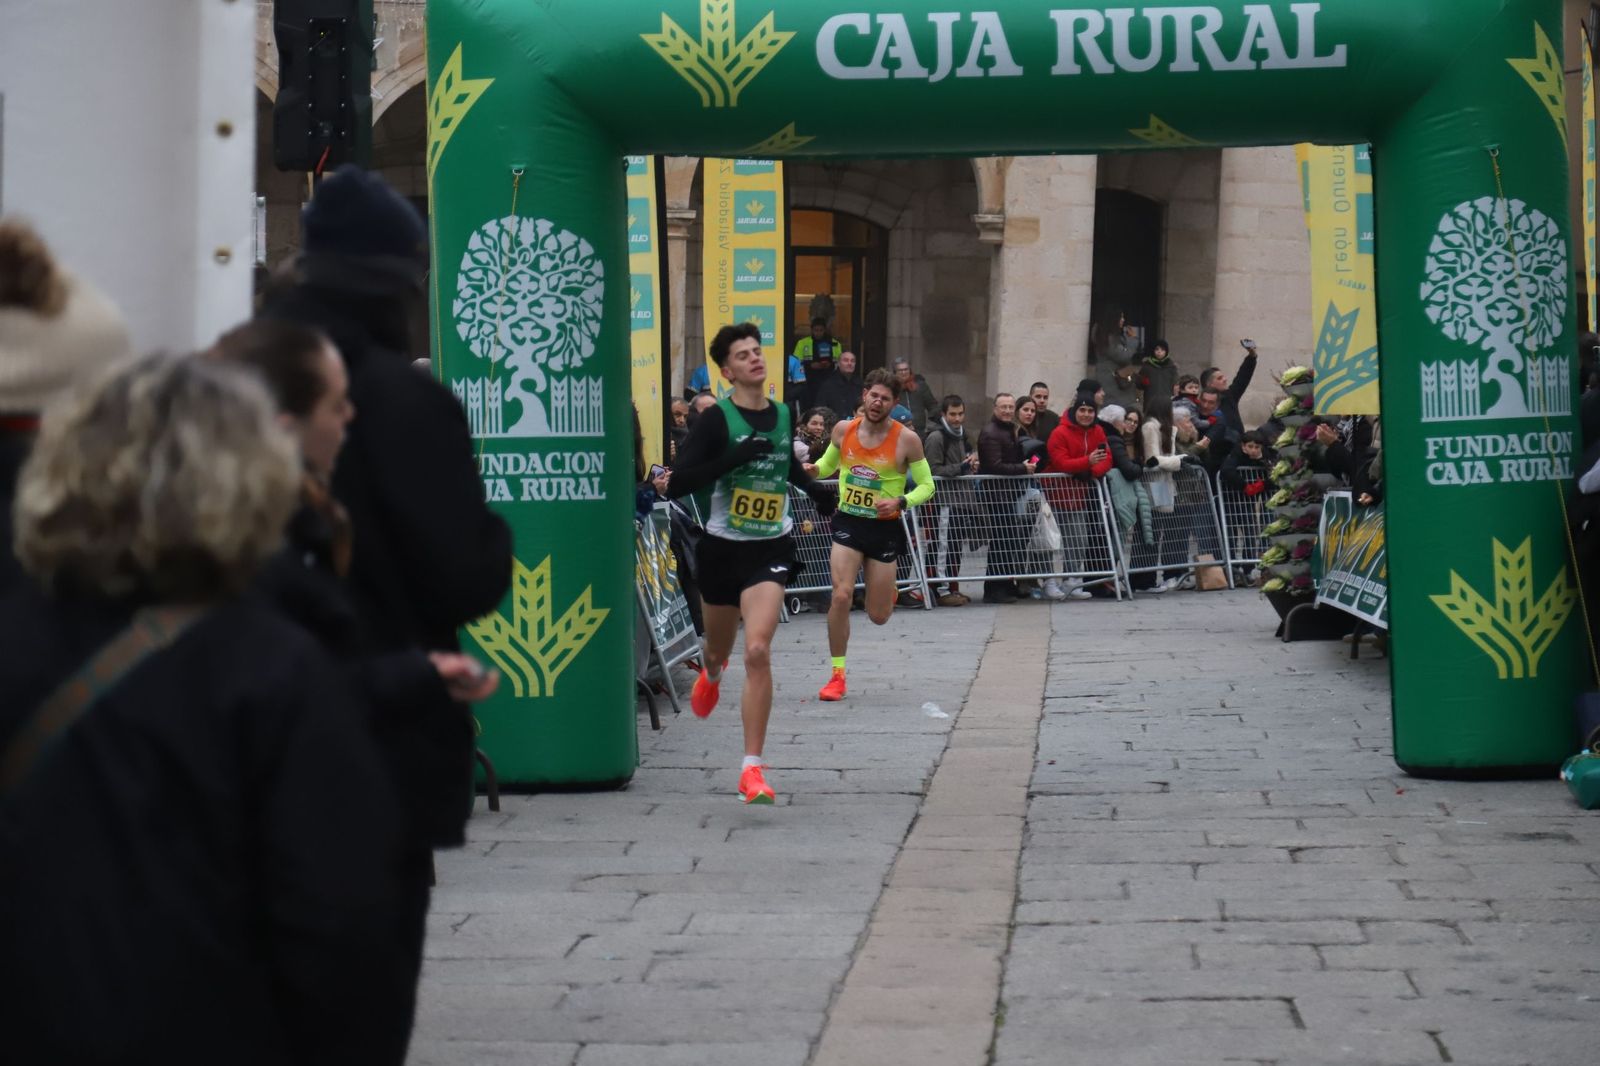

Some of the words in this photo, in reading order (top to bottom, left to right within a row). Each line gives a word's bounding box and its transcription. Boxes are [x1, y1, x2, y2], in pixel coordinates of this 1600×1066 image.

[815, 12, 1023, 83] CAJA
[1049, 2, 1348, 76] RURAL
[1424, 432, 1573, 459] FUNDACION
[1426, 460, 1494, 486] CAJA
[1499, 457, 1575, 482] RURAL
[520, 477, 607, 502] RURAL
[846, 487, 874, 507] 756
[734, 494, 778, 521] 695
